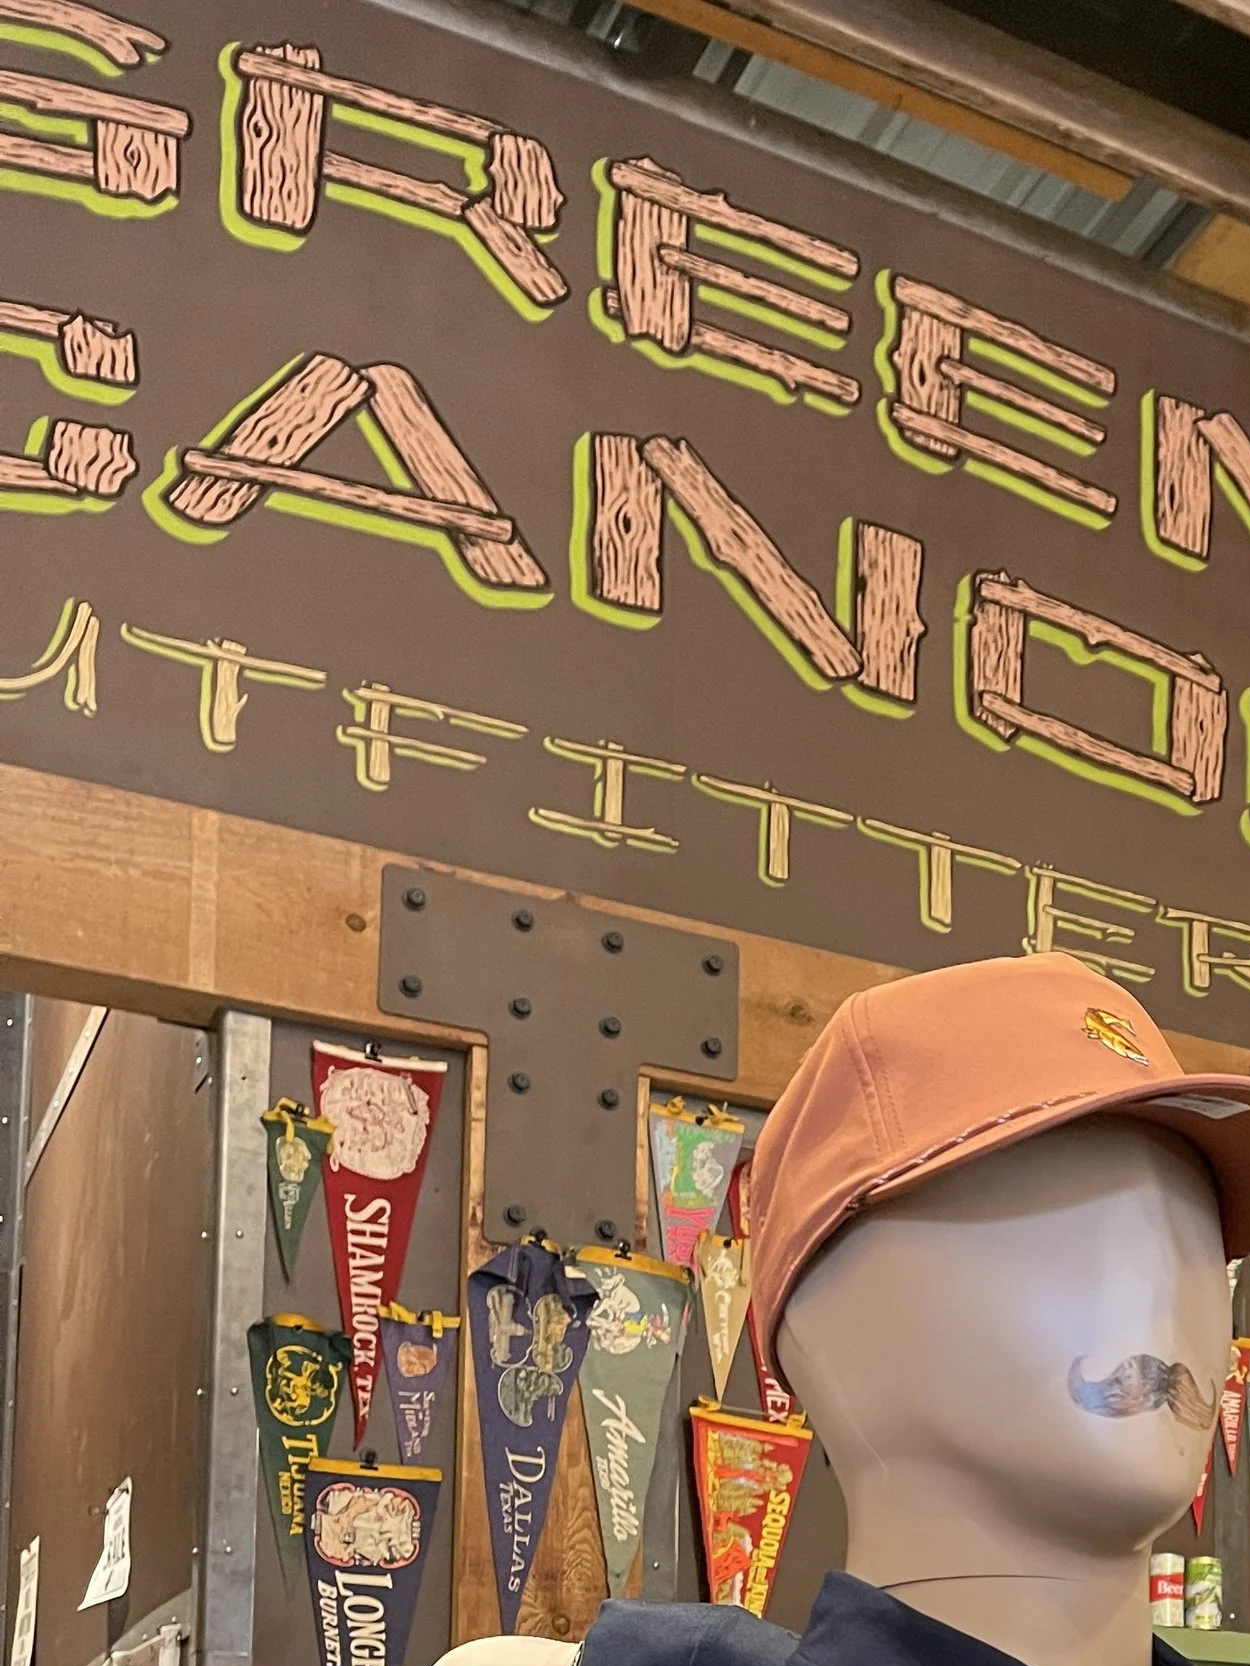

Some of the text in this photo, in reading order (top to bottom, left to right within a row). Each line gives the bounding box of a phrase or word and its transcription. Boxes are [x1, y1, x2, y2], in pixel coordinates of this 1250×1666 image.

[499, 1480, 515, 1534] TEXAS
[504, 1446, 546, 1593] DALLAS
[592, 1386, 647, 1542] Amarillo
[760, 1489, 792, 1569] SEQUOIA
